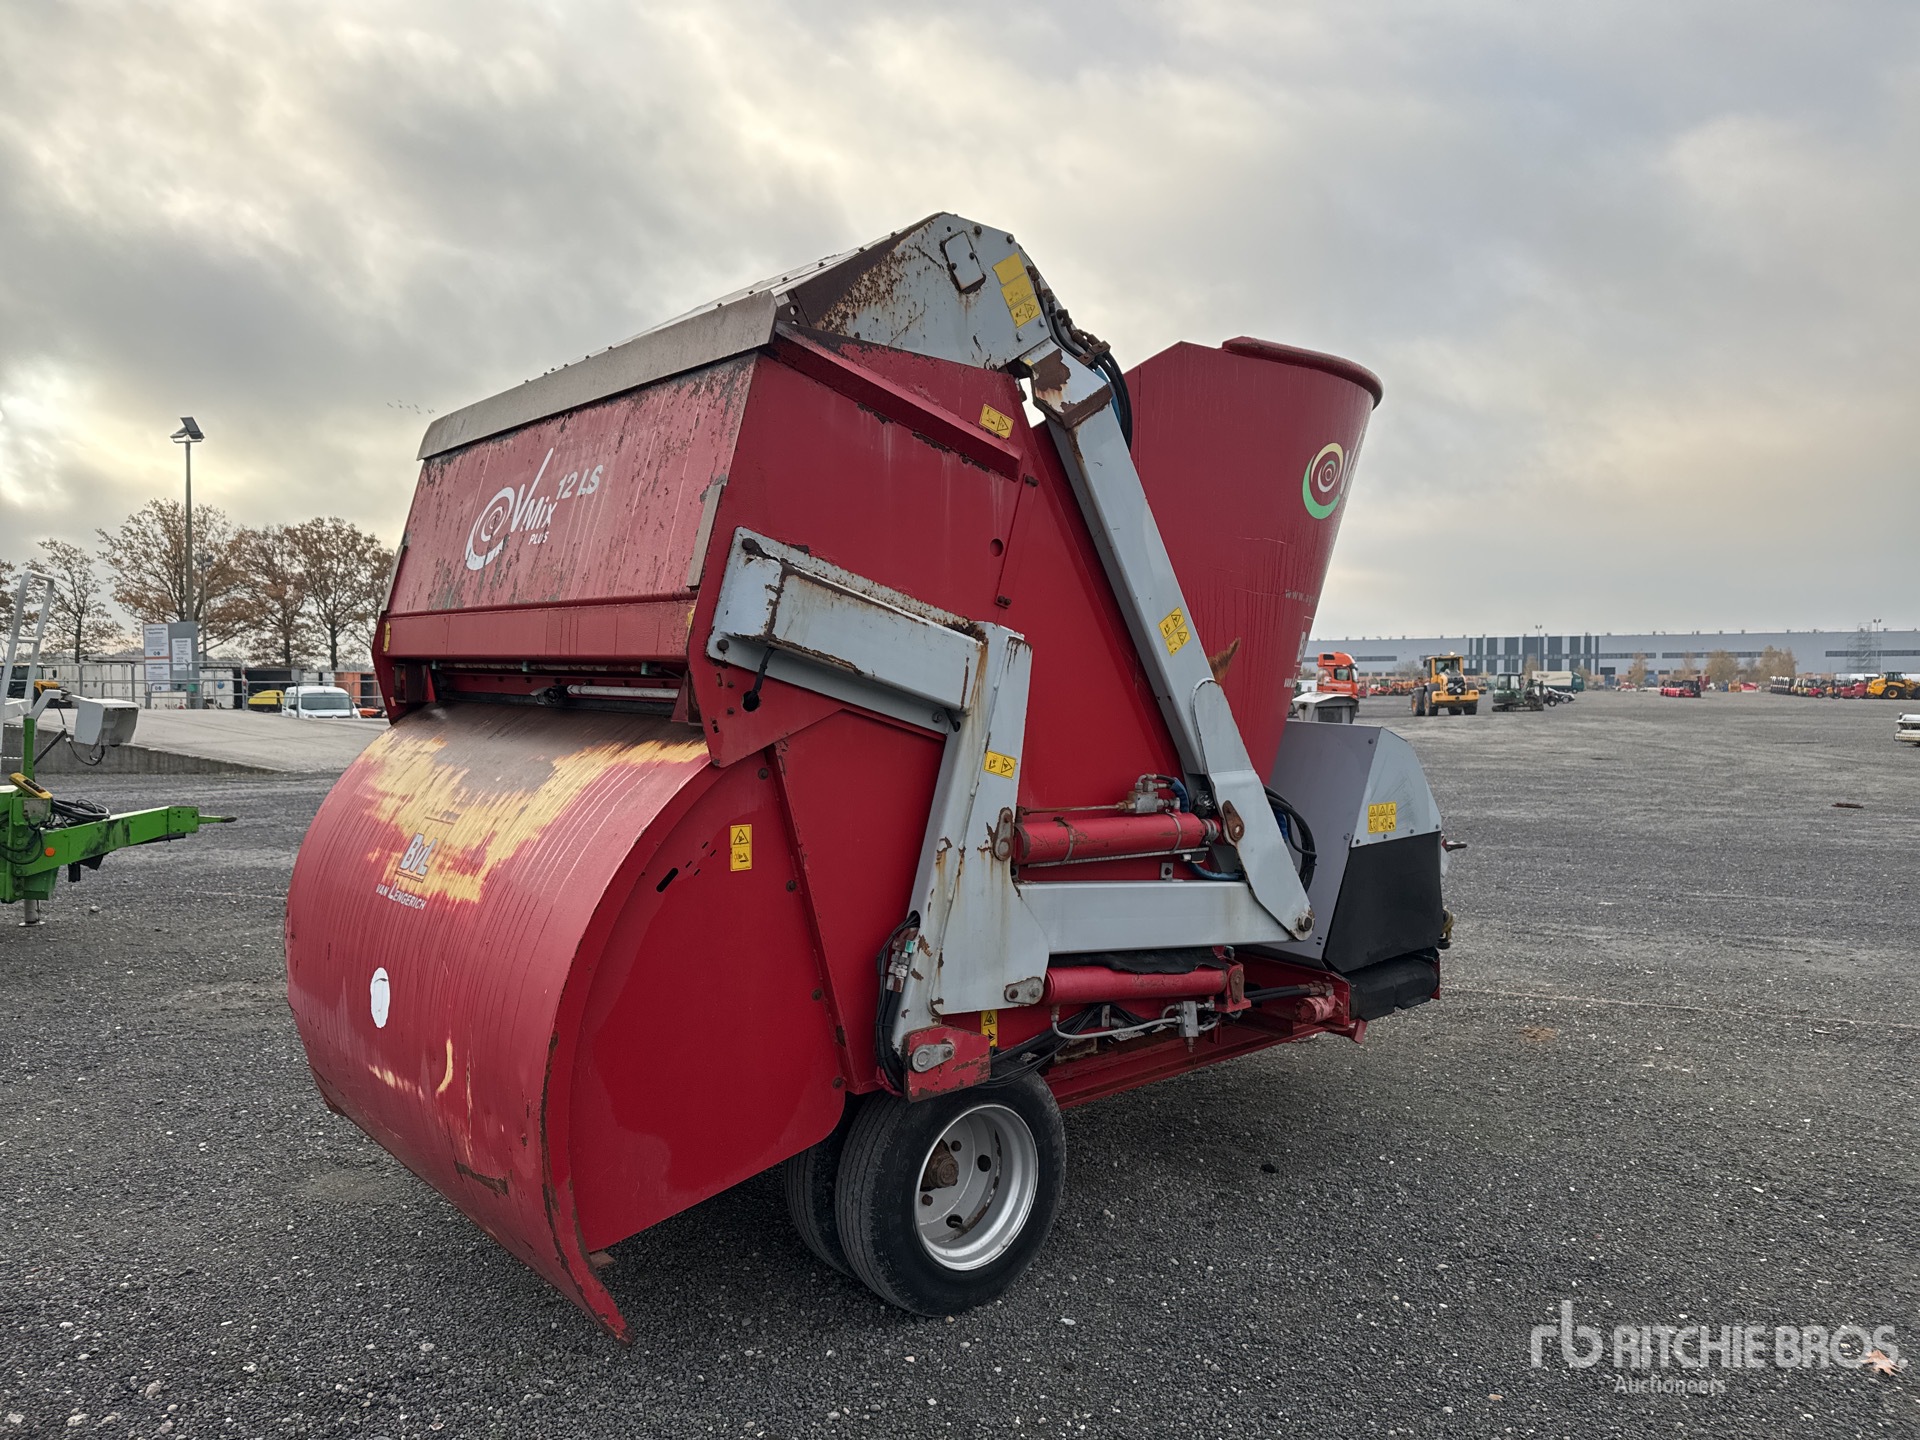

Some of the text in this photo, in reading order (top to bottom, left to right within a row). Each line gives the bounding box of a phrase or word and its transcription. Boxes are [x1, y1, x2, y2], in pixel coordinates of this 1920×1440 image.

[556, 471, 578, 500] 12
[577, 464, 603, 496] LS
[528, 531, 550, 546] PLUS
[375, 883, 390, 897] VAN
